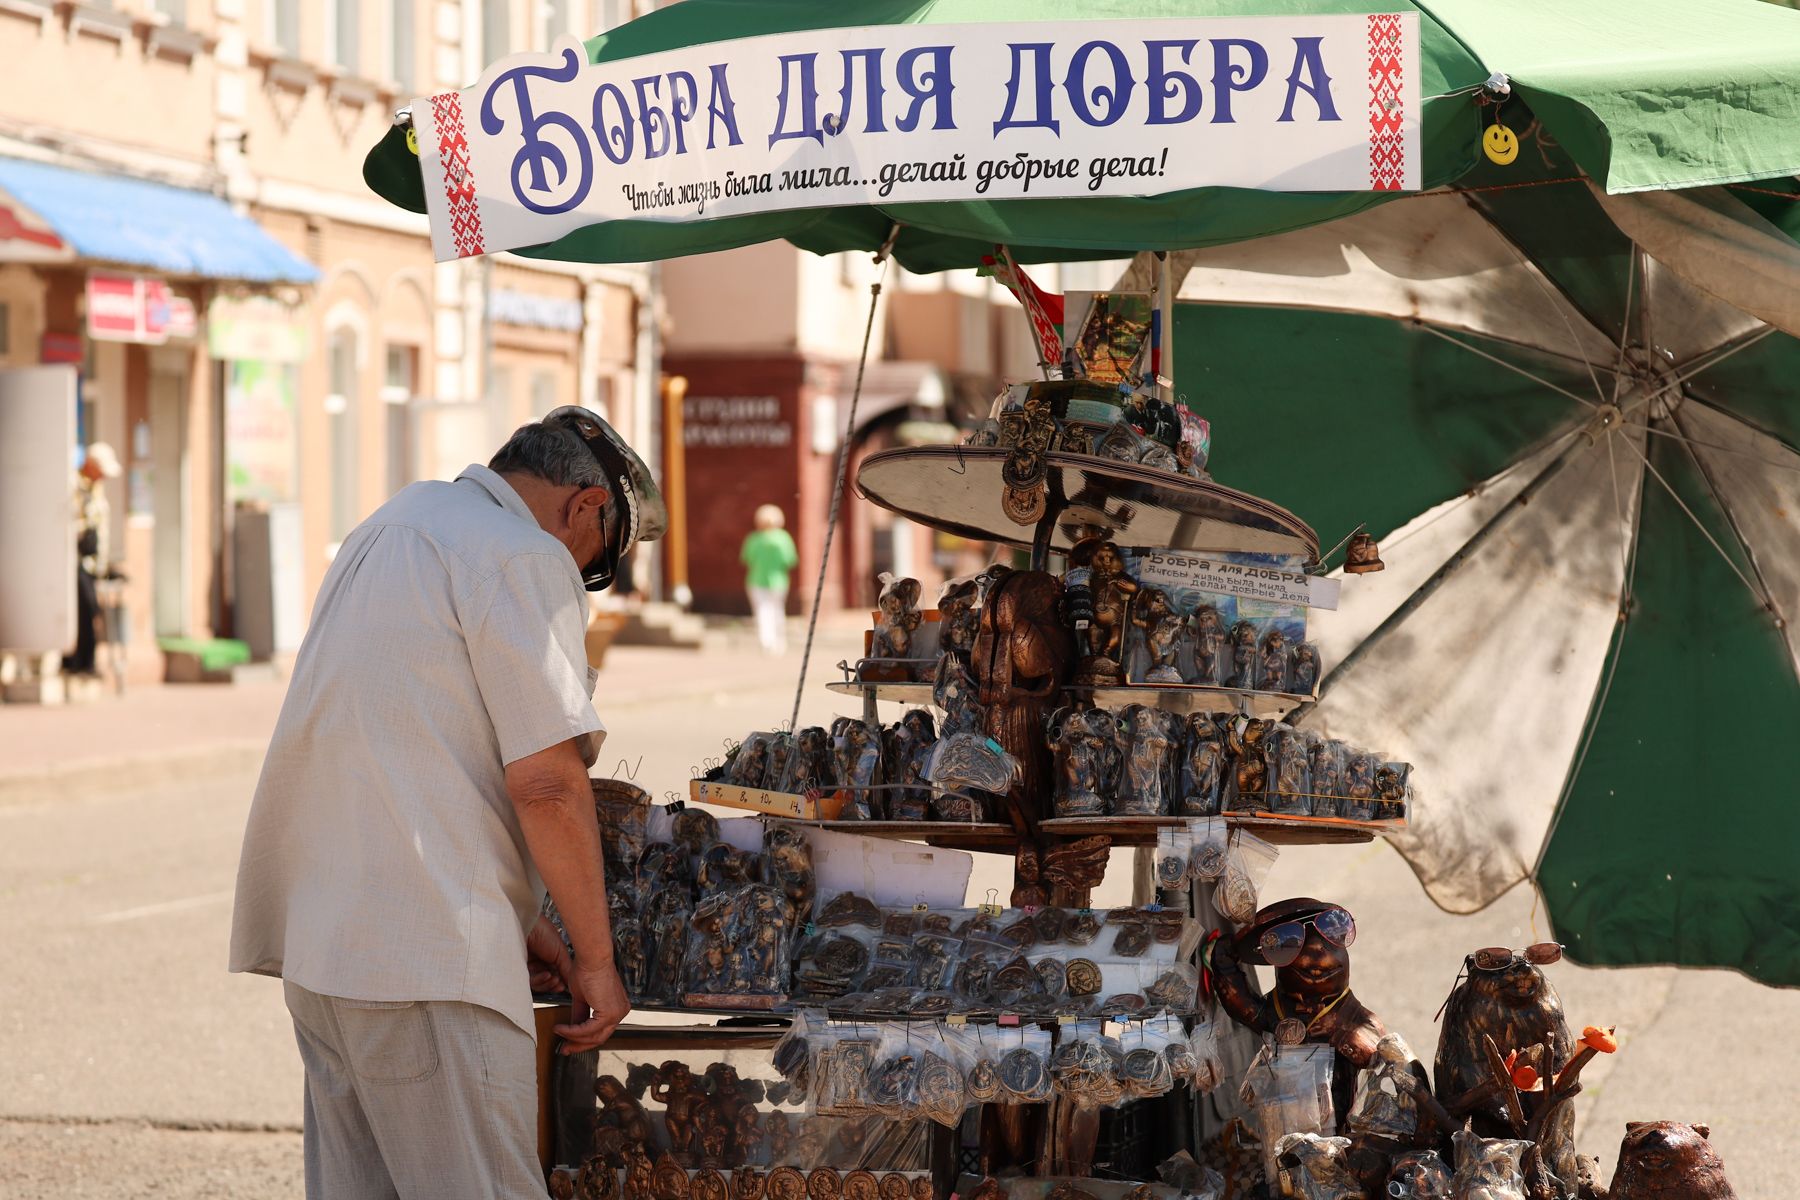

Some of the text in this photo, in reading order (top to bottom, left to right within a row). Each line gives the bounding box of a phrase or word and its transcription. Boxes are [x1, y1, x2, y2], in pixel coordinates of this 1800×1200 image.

[768, 45, 959, 152] ДЛЯ
[993, 36, 1343, 140] ДОБРА
[622, 181, 675, 211] Чтобы
[678, 180, 721, 214] жизнь
[725, 171, 773, 197] была
[976, 152, 1079, 193] добрые
[1088, 147, 1169, 191] дела!
